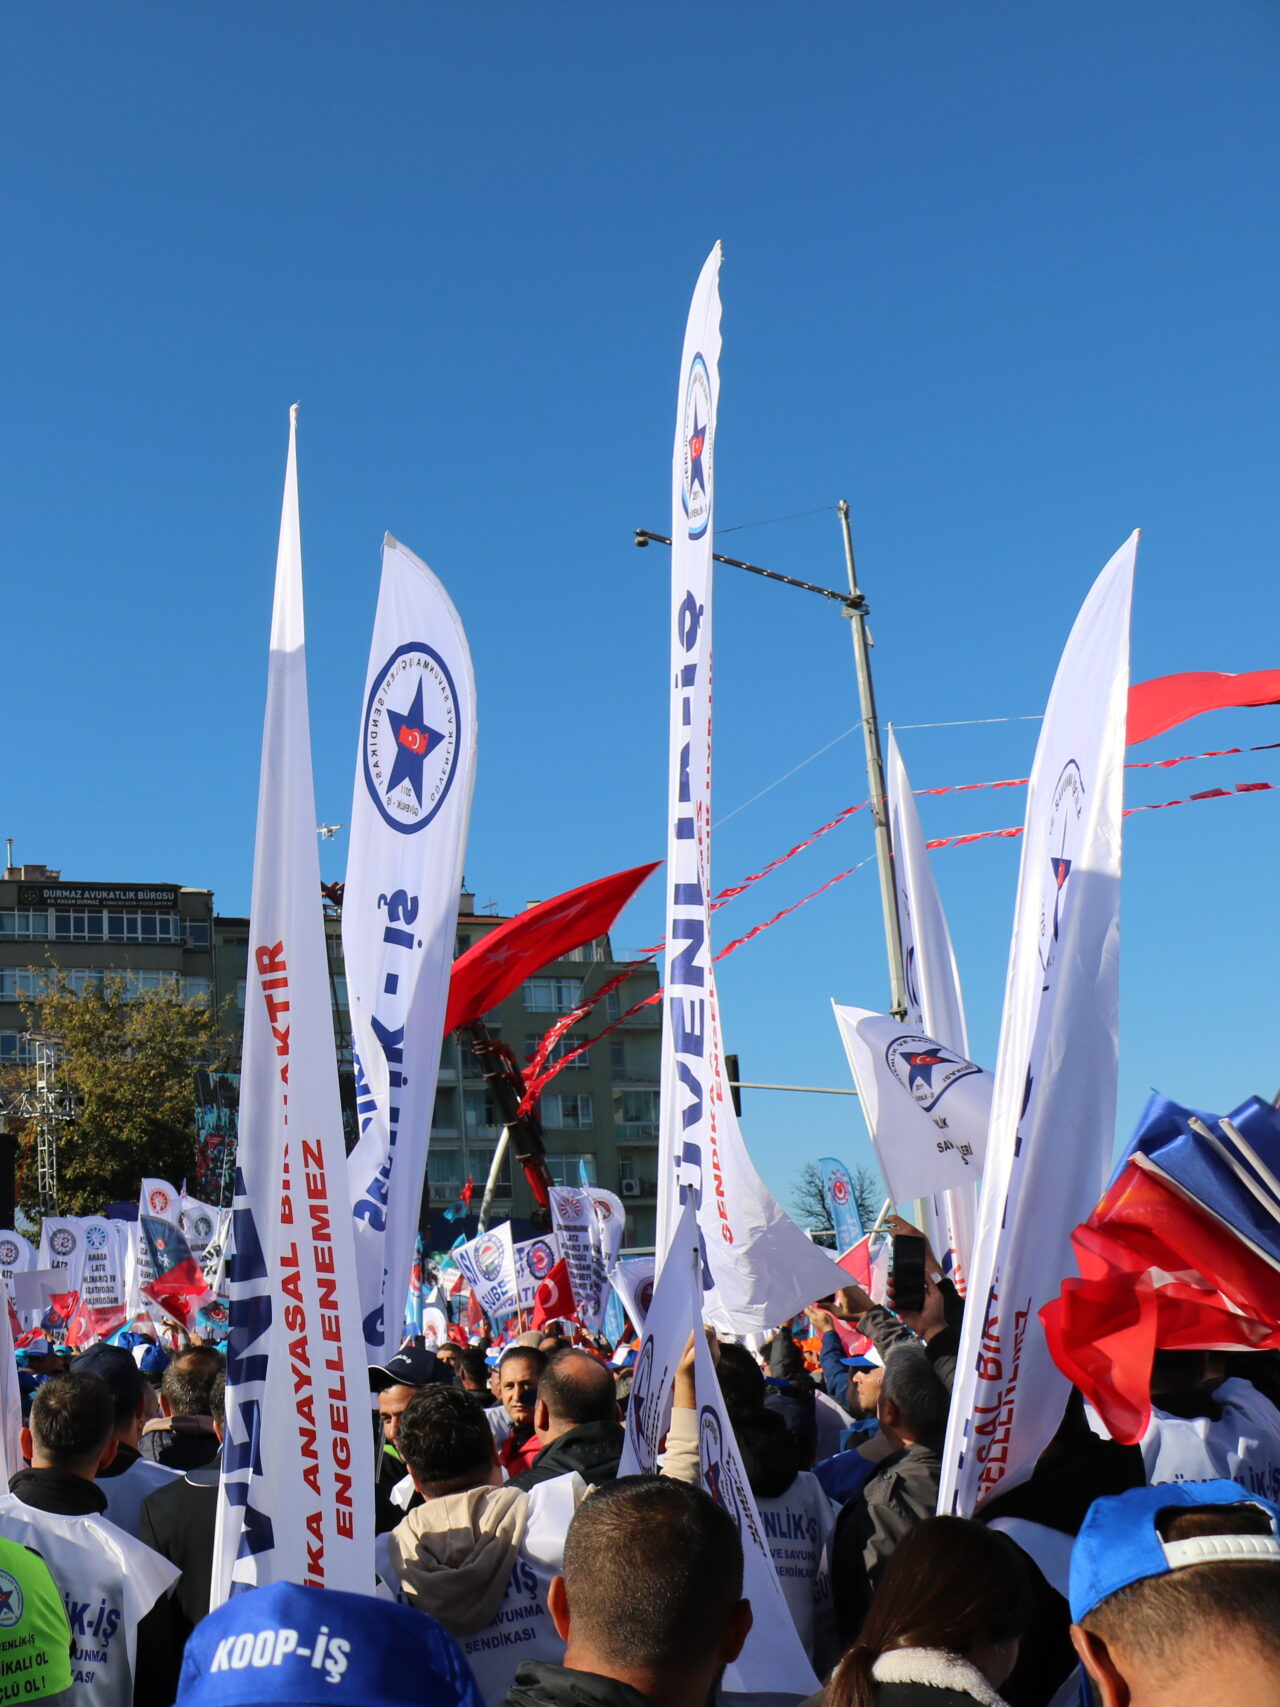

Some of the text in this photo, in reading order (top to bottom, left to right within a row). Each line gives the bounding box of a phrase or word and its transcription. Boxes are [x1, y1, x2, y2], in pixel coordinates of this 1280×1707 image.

[43, 889, 175, 901] DURMAZ AVUKATLIK BÜROSU
[301, 1138, 354, 1541] ENGELLENEMEZ
[280, 1242, 322, 1497] ANAYASAL
[210, 1624, 351, 1685] KOOP-İŞ
[465, 1627, 537, 1655] SENDİKASI
[35, 1651, 49, 1667] OL
[24, 1680, 40, 1694] OL
